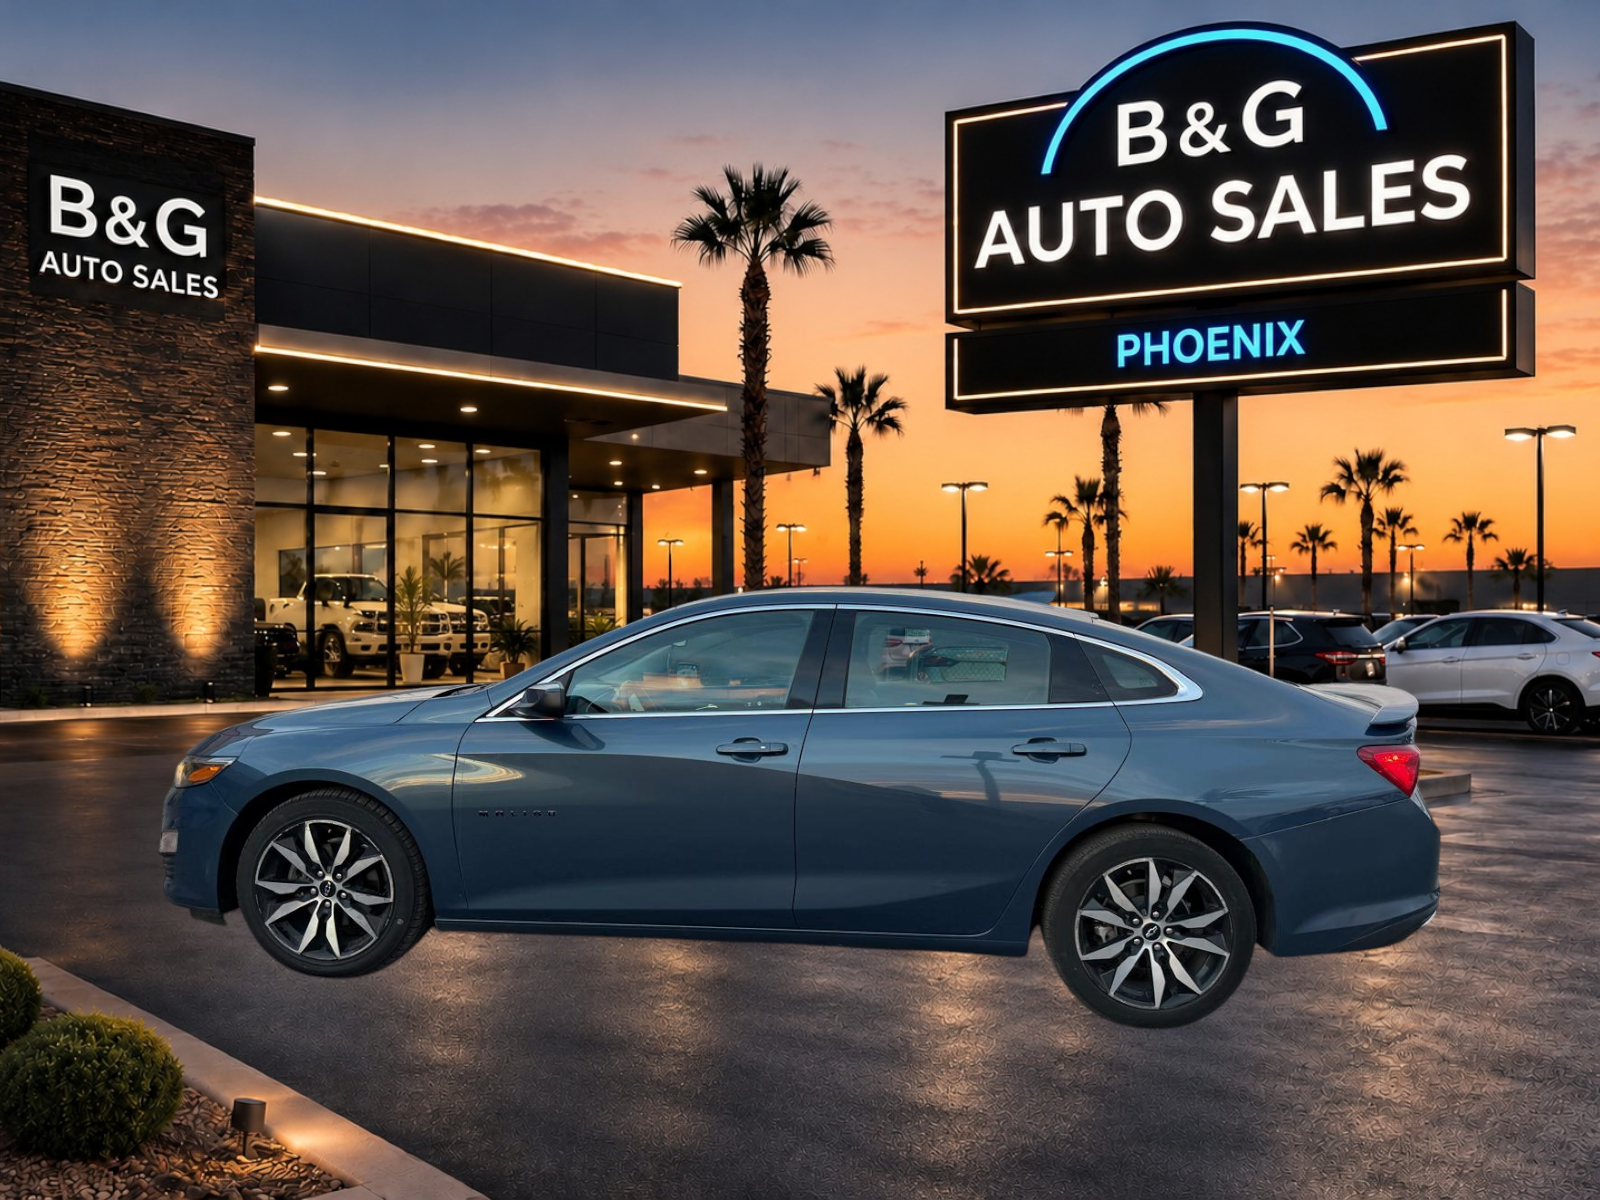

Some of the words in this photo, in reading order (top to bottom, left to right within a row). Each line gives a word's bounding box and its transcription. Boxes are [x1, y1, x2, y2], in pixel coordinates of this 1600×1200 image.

[49, 174, 207, 258] B&G
[974, 189, 1184, 269] AUTO
[1210, 154, 1471, 243] SALES
[39, 250, 123, 284] AUTO
[132, 264, 219, 299] SALES
[1117, 319, 1306, 368] PHOENIX
[478, 809, 557, 818] MALIBU
